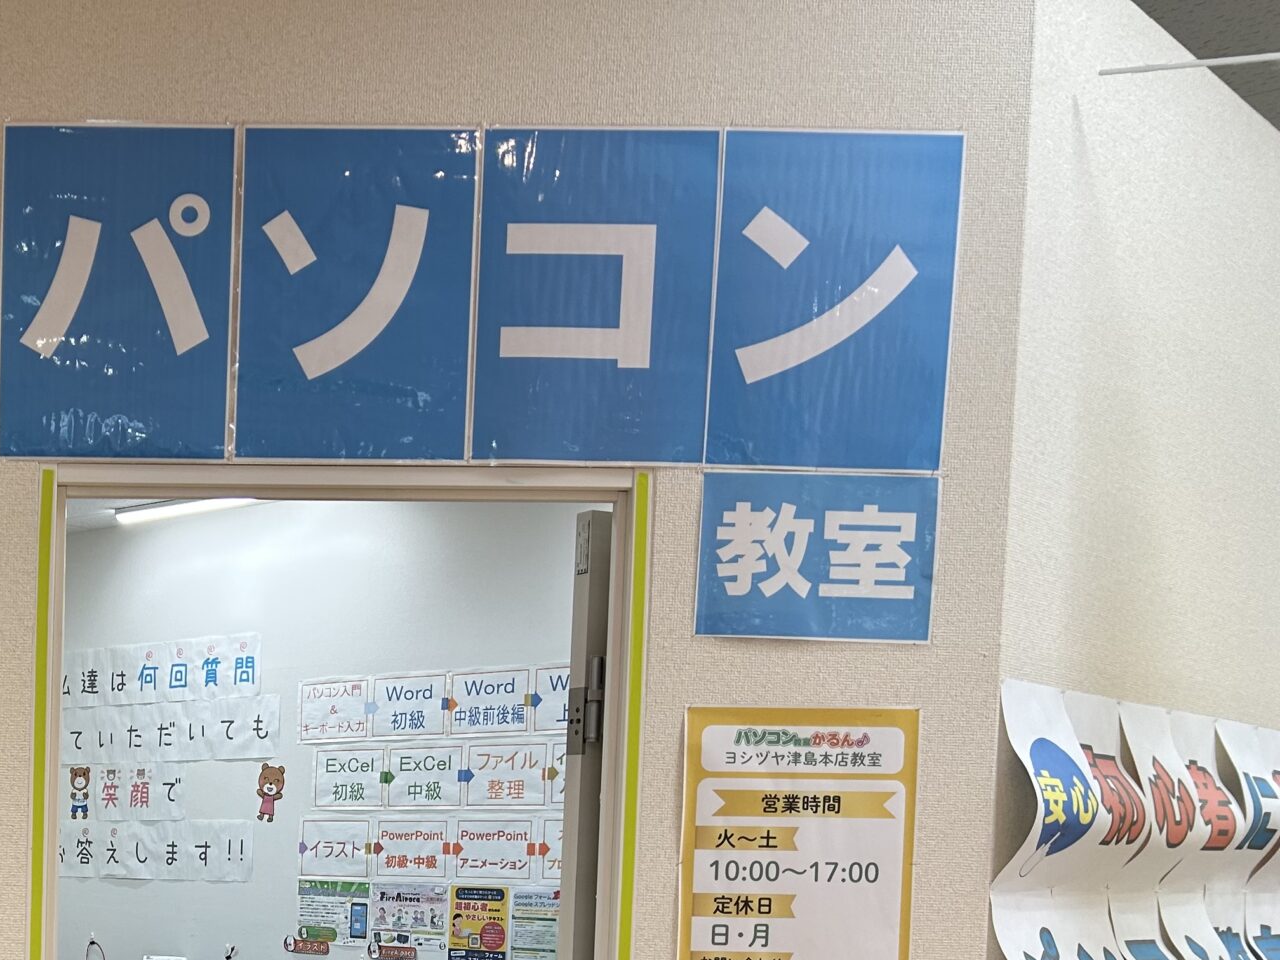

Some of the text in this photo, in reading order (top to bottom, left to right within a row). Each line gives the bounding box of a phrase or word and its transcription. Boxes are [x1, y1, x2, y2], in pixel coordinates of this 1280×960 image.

[21, 194, 918, 383] パソコン
[716, 501, 916, 599] 教室
[307, 684, 363, 699] パソコン入門
[385, 684, 433, 702] Word
[464, 677, 516, 696] Word
[329, 704, 339, 715] &
[454, 703, 525, 727] 中級前後編
[302, 721, 366, 734] キーボード入力
[391, 710, 426, 731] 初級
[326, 758, 375, 773] ExCel
[399, 755, 452, 772] ExCel
[476, 751, 539, 771] ファイル
[725, 751, 882, 768] ヨシヅヤ津島本店教室
[101, 778, 182, 809] 笑顔で
[332, 783, 366, 801] 初級
[407, 781, 442, 801] 中級
[487, 779, 525, 801] 整理
[1037, 770, 1098, 826] 安心
[761, 793, 842, 815] 営業時間
[381, 831, 444, 842] PowerPoint
[460, 831, 528, 842] PowerPoint
[309, 840, 362, 859] イラスト
[385, 856, 438, 870] 初級・中級
[459, 857, 528, 871] アニメーション
[713, 895, 773, 917] 定休日
[710, 923, 770, 948] 日・月
